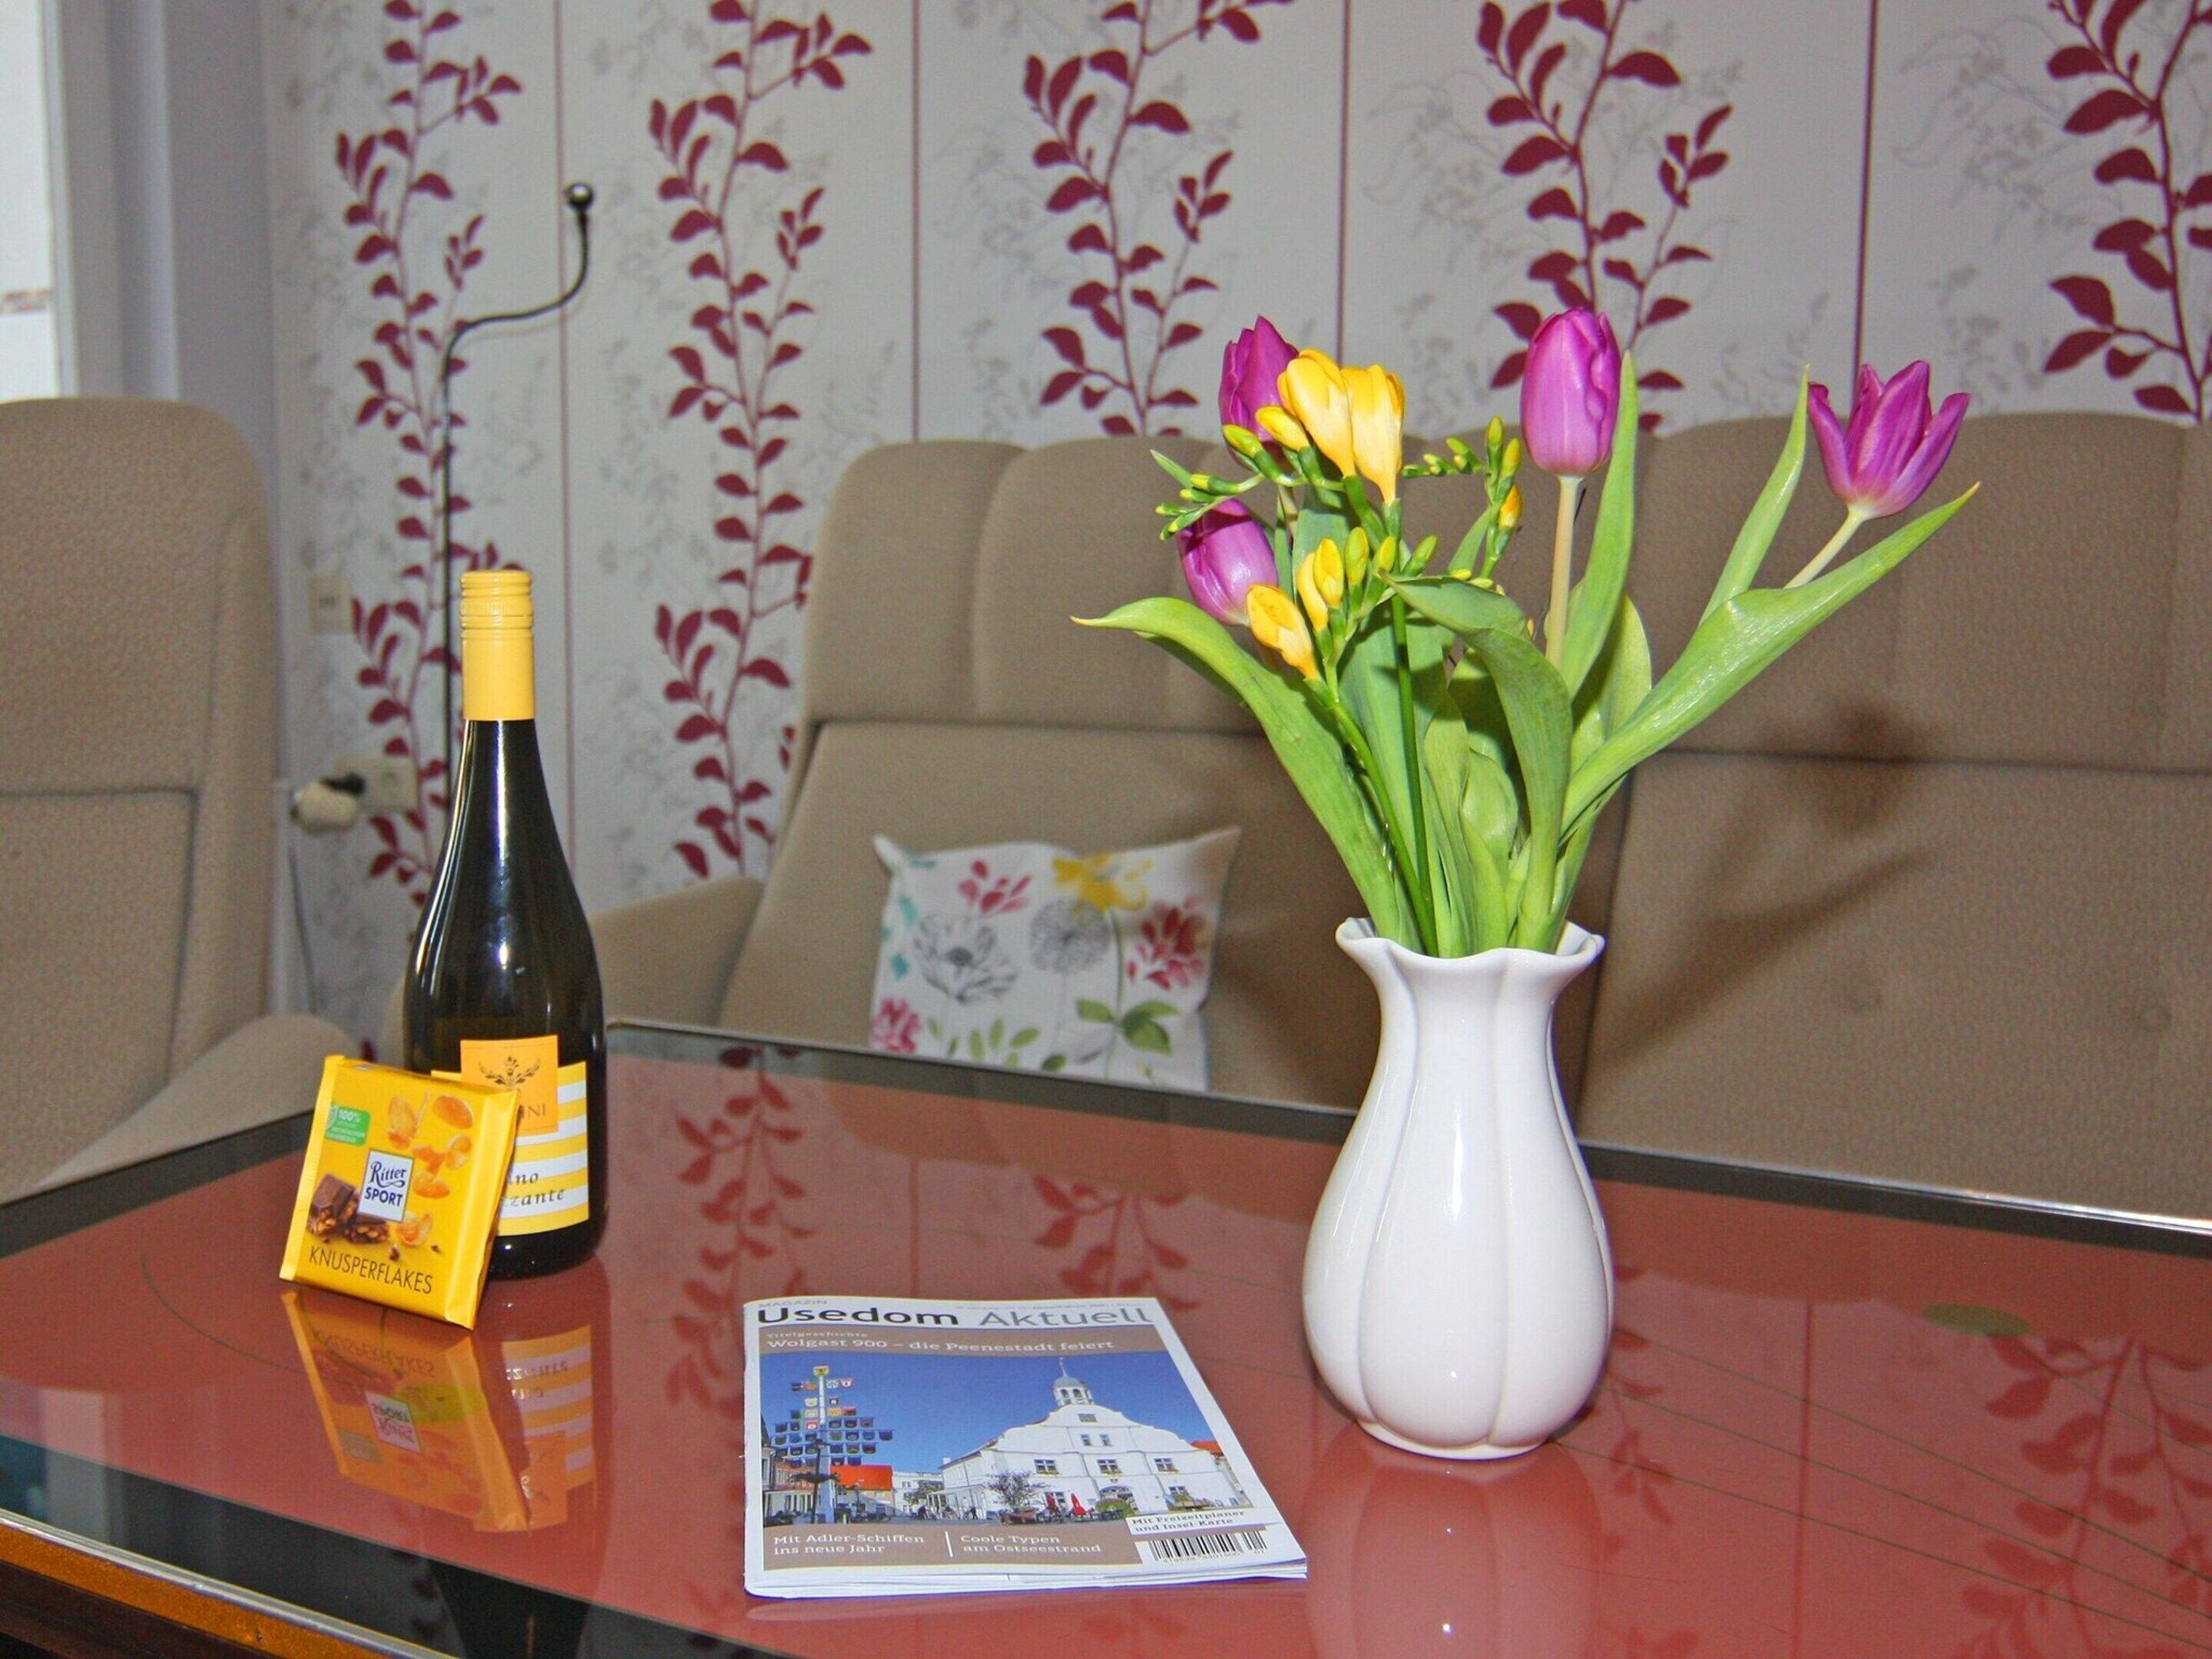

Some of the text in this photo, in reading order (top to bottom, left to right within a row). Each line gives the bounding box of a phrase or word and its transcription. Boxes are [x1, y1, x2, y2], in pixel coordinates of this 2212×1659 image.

[518, 1104, 546, 1119] NI
[370, 1161, 407, 1188] Ritter
[364, 1187, 403, 1207] SPORT
[309, 1245, 433, 1295] KNUSPERFLAKES
[758, 1300, 827, 1308] MAGAZIN
[757, 1307, 1152, 1326] Usedom Aktuell
[767, 1338, 848, 1349] Wolgast
[853, 1339, 888, 1348] 900
[909, 1341, 940, 1350] die
[946, 1343, 1055, 1352] Peenestadt
[1059, 1341, 1115, 1351] feiert
[1132, 1510, 1246, 1525] Mit Freizeitplaner
[1134, 1518, 1234, 1532] und Insel-Karte
[774, 1534, 925, 1545] Mit Adler-Schiffen
[1007, 1535, 1061, 1545] Typen
[774, 1545, 799, 1555] ins
[849, 1544, 886, 1554] Jahr
